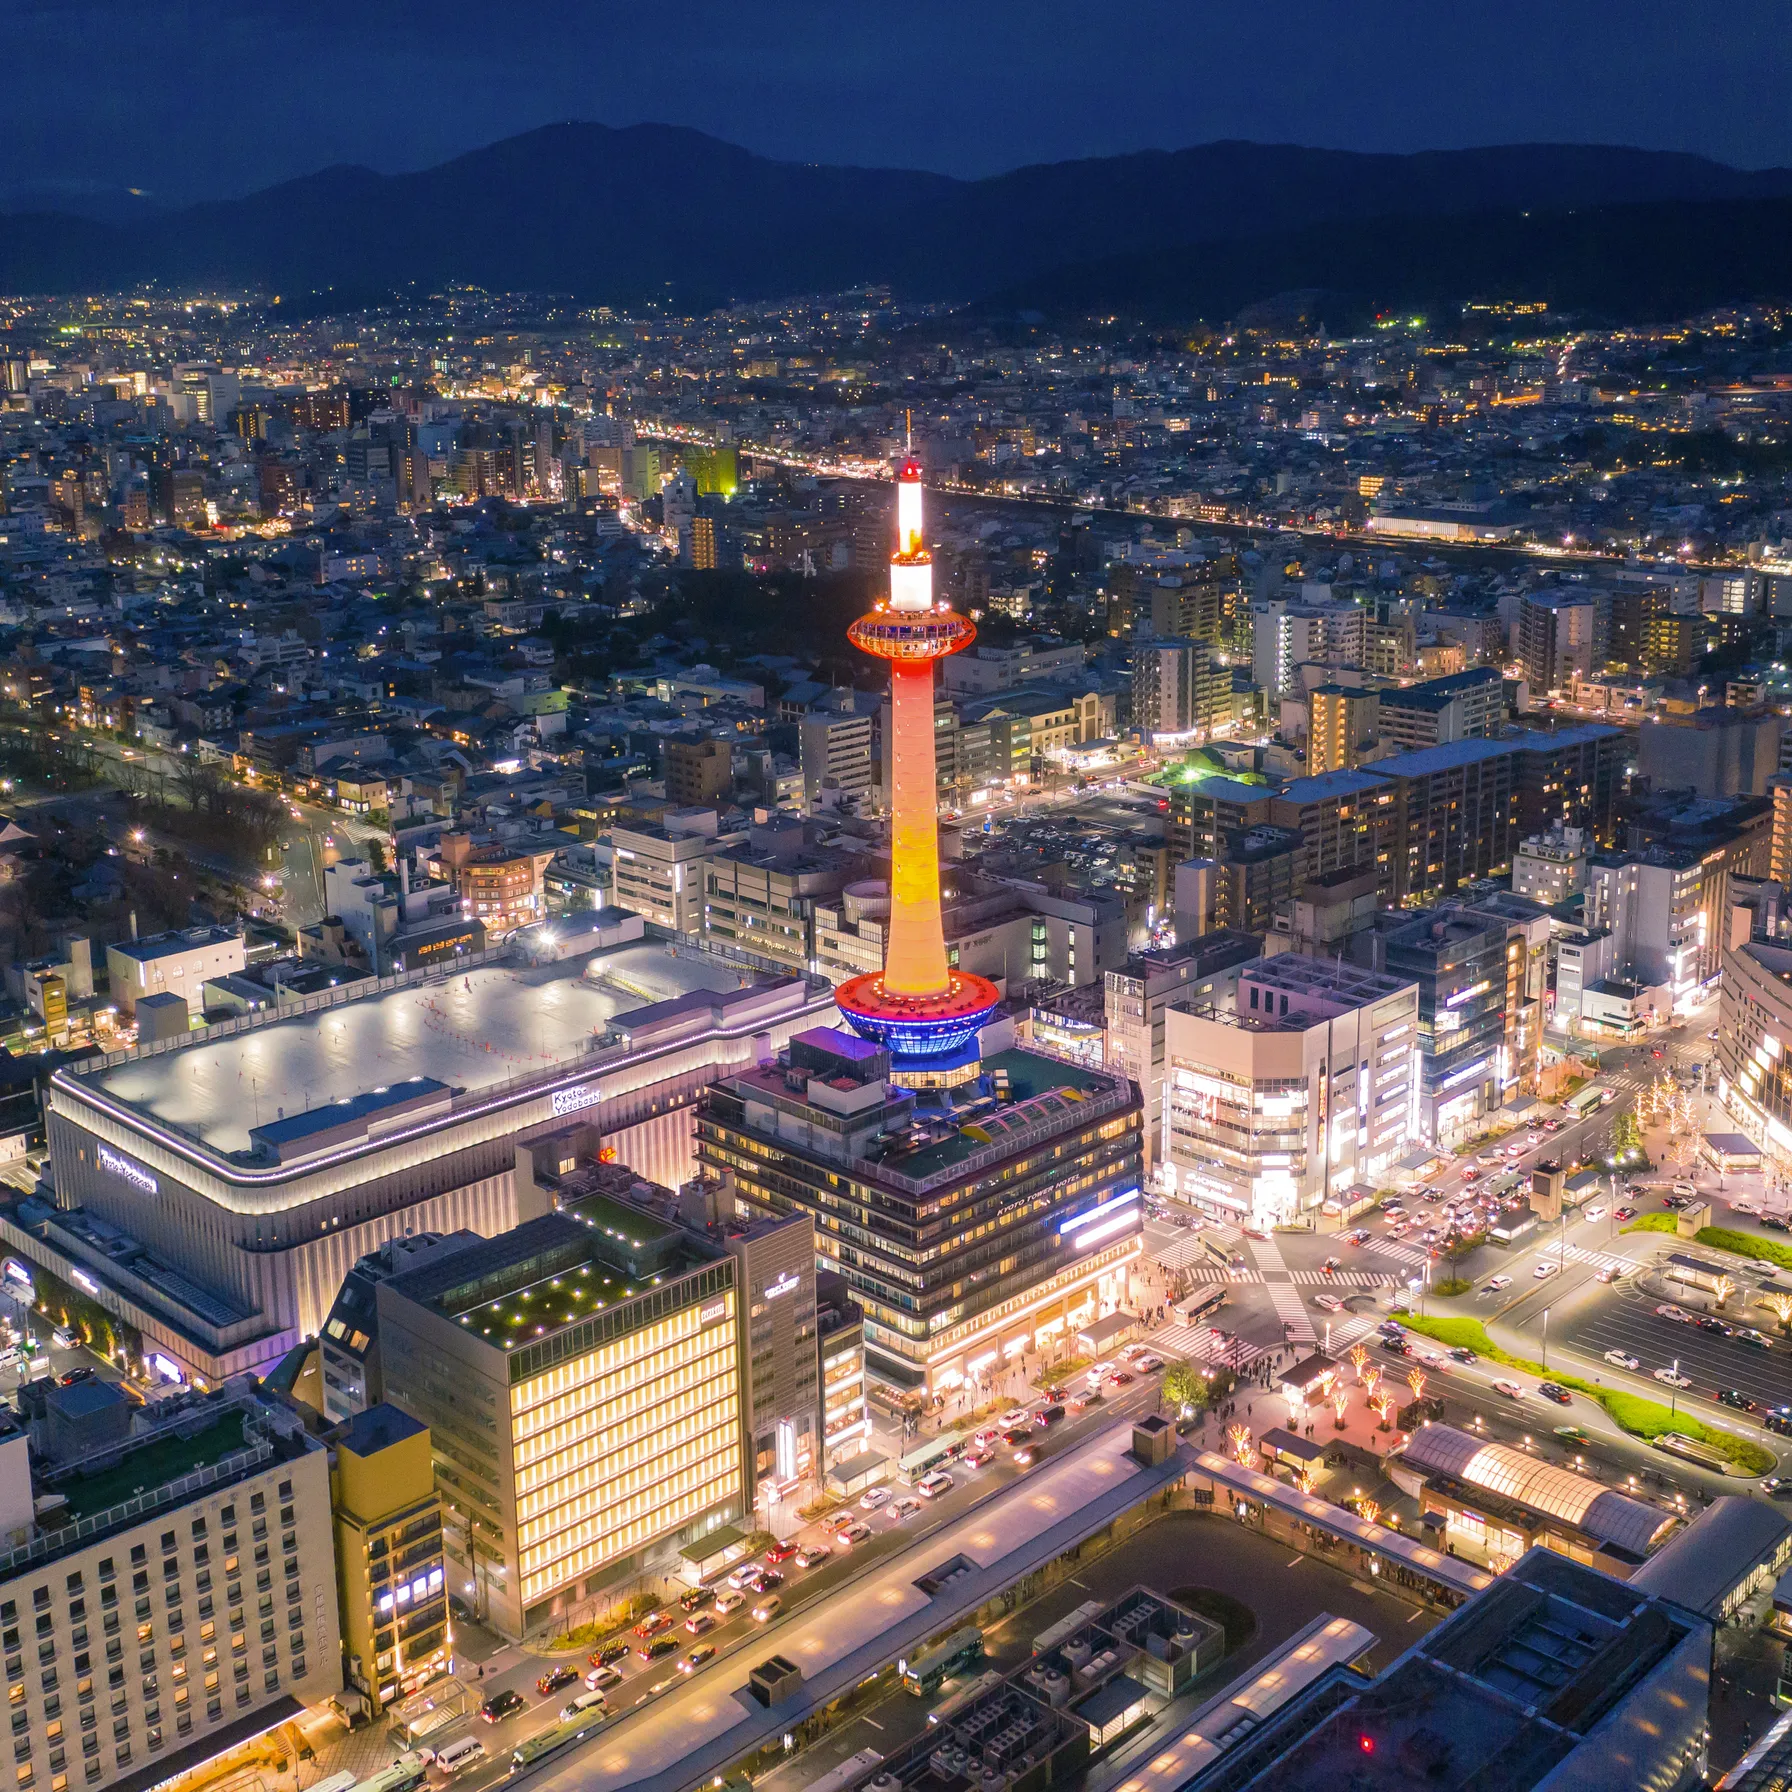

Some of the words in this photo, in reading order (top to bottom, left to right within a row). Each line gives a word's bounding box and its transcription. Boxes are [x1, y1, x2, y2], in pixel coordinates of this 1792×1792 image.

[554, 1087, 587, 1104] Kyoto-
[555, 1091, 601, 1114] Yodobashi
[997, 1199, 1025, 1217] KYOTO
[1027, 1185, 1054, 1202] TOWER
[1055, 1173, 1080, 1189] HOTEL
